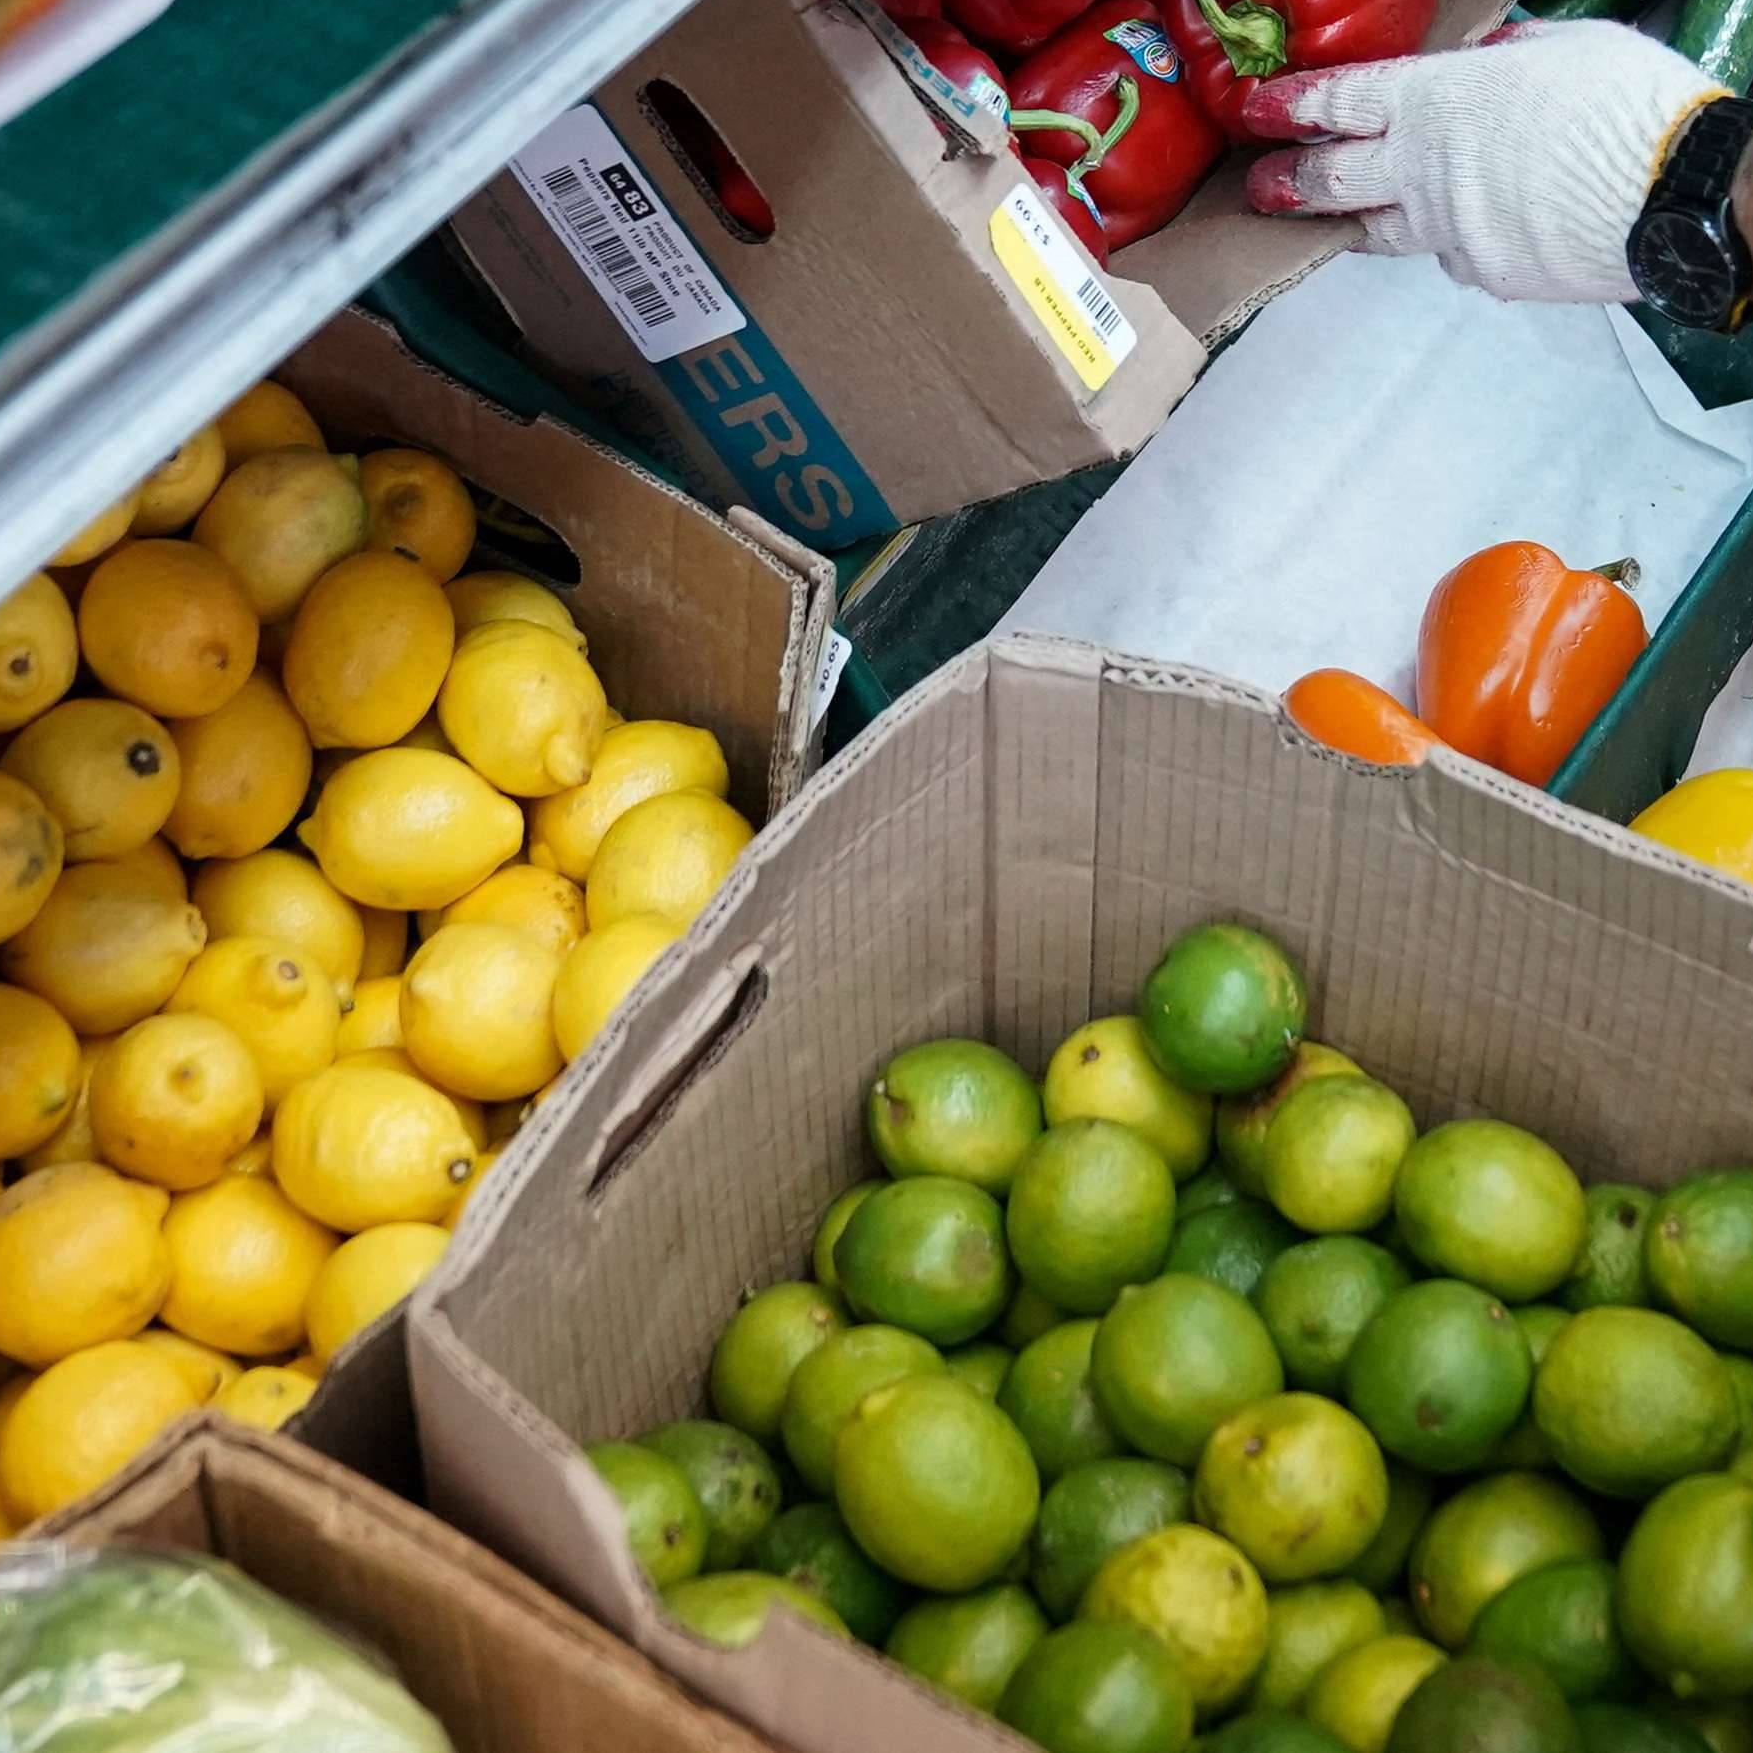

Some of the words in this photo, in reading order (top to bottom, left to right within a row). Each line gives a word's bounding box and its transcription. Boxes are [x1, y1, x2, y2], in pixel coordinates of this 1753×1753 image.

[576, 157, 612, 201] Peppers
[608, 202, 631, 225] Red
[643, 250, 663, 270] MP
[621, 189, 650, 217] 83
[1013, 196, 1051, 246] $3.99
[642, 225, 673, 261] PRODUIT
[683, 282, 712, 315] CANADA
[651, 221, 684, 260] PRODUCT
[682, 263, 695, 274] OF
[693, 279, 722, 312] CANADA
[1032, 275, 1046, 292] LB
[1043, 292, 1077, 338] PEPPER
[1075, 337, 1096, 363] RED
[818, 638, 840, 691] $0.65
